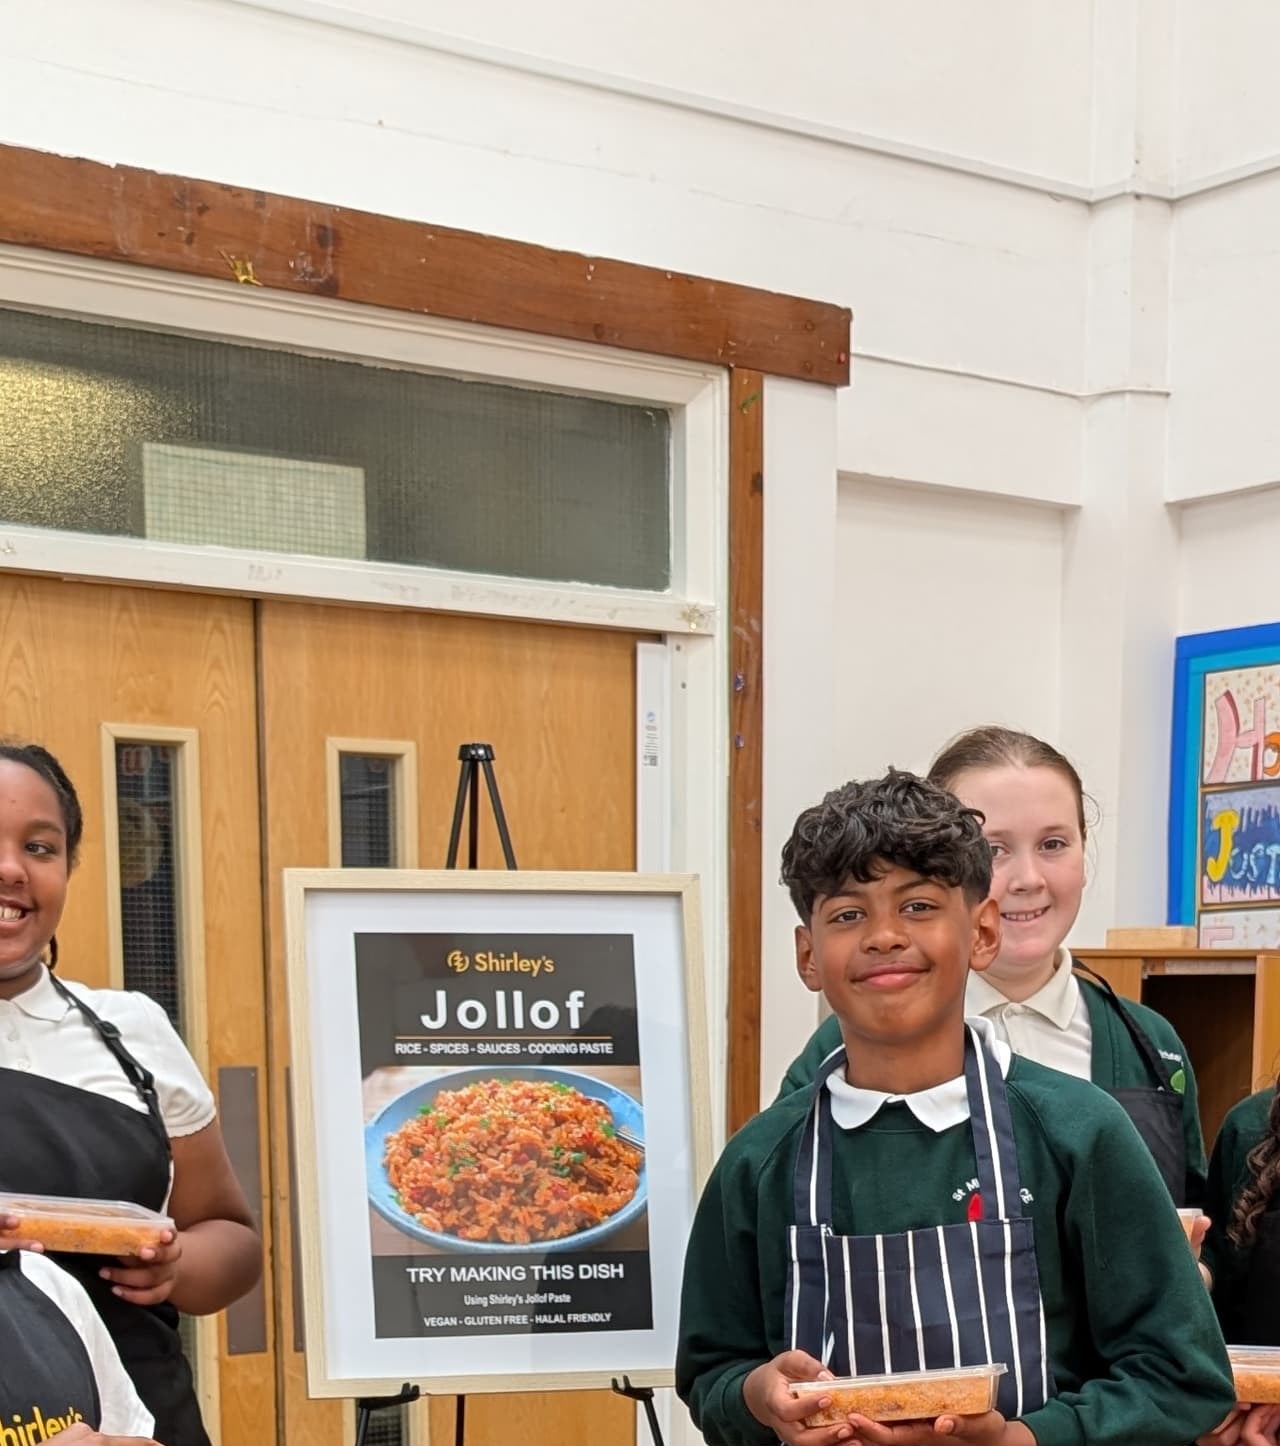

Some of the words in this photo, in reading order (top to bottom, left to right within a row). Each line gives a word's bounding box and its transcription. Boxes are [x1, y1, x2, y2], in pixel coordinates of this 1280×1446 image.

[474, 951, 555, 977] Shirley's
[420, 989, 585, 1030] Jollof
[395, 1042, 422, 1055] RICE
[429, 1042, 470, 1055] SPICES
[477, 1042, 521, 1055] SAUCES
[528, 1042, 578, 1055] COOKING
[579, 1042, 614, 1055] PASTE
[406, 1267, 446, 1283] TRY
[450, 1265, 526, 1282] MAKING
[530, 1264, 575, 1280] THIS
[578, 1263, 625, 1279] DISH
[463, 1295, 489, 1307] Using
[489, 1293, 523, 1306] Shirley's
[524, 1293, 548, 1304] Jollof
[548, 1293, 571, 1303] Paste
[424, 1316, 458, 1327] VEGAN
[464, 1315, 503, 1326] GLUTEN
[503, 1315, 529, 1325] FREE
[535, 1314, 566, 1324] HALAL
[566, 1312, 612, 1323] FRIENDLY
